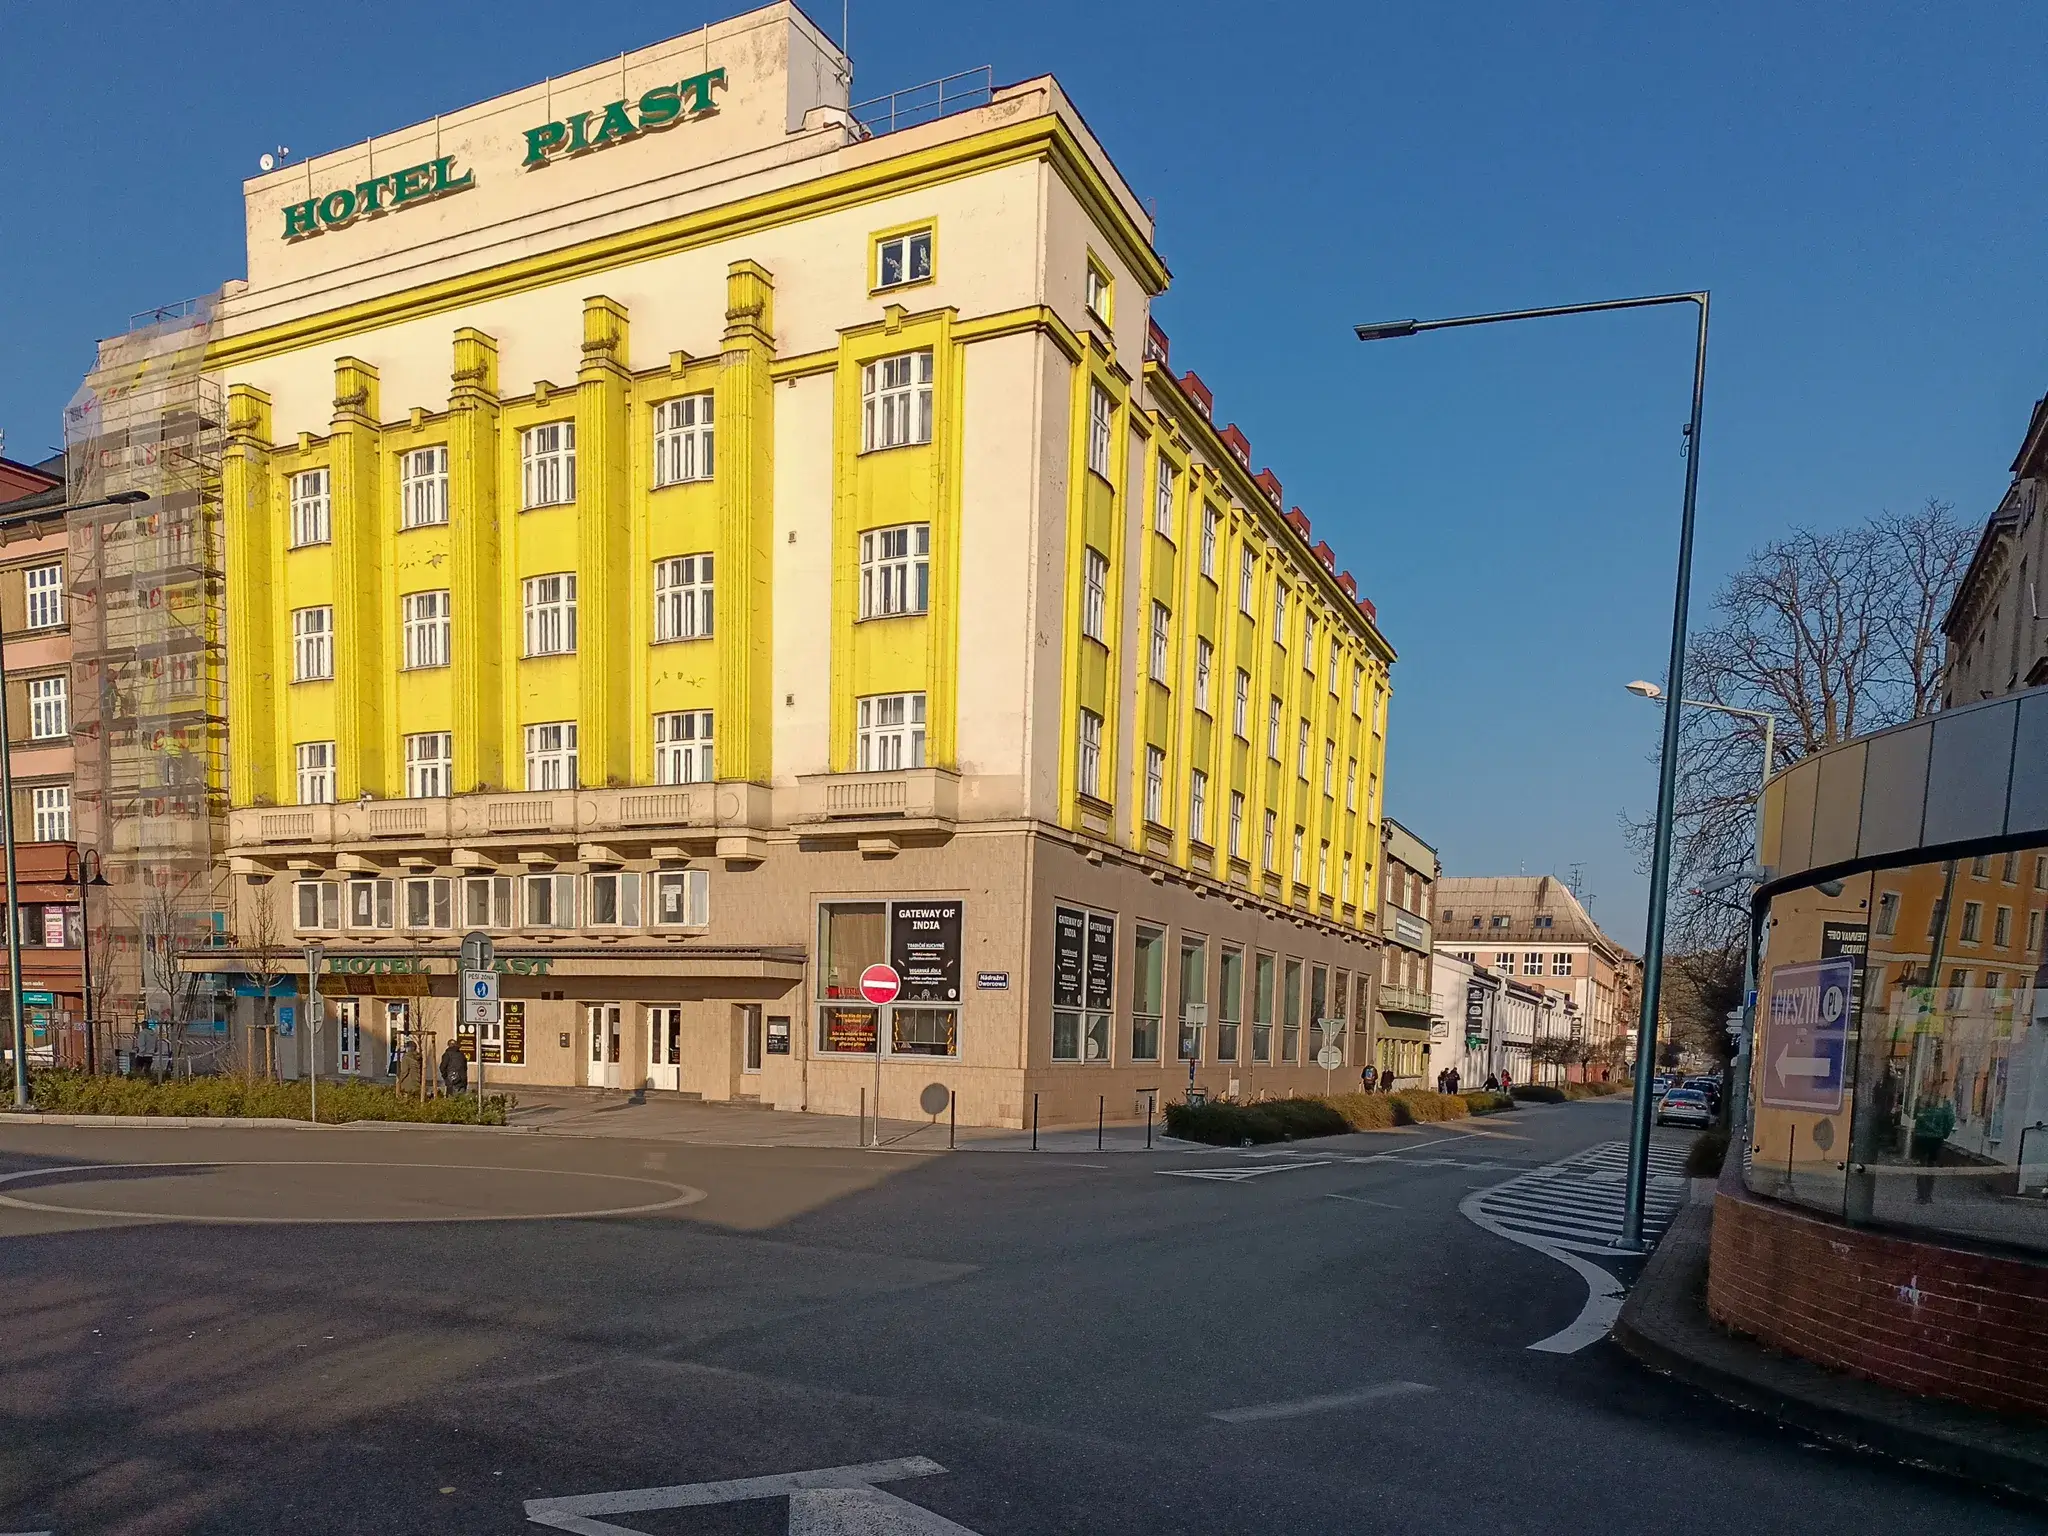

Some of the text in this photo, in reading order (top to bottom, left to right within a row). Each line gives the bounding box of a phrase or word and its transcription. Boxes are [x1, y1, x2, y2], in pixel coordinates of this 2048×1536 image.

[281, 68, 726, 240] HOTEL PIAST
[898, 909, 956, 918] GATEWAY OF
[912, 921, 940, 930] INDIA
[1058, 915, 1083, 928] GATEWAY OF
[1064, 928, 1077, 938] INDIA
[1089, 922, 1112, 934] GATEWAY OF
[1094, 933, 1106, 944] INDIA
[328, 957, 432, 975] HOTEL
[1773, 986, 1837, 1025] CIESZYN PL
